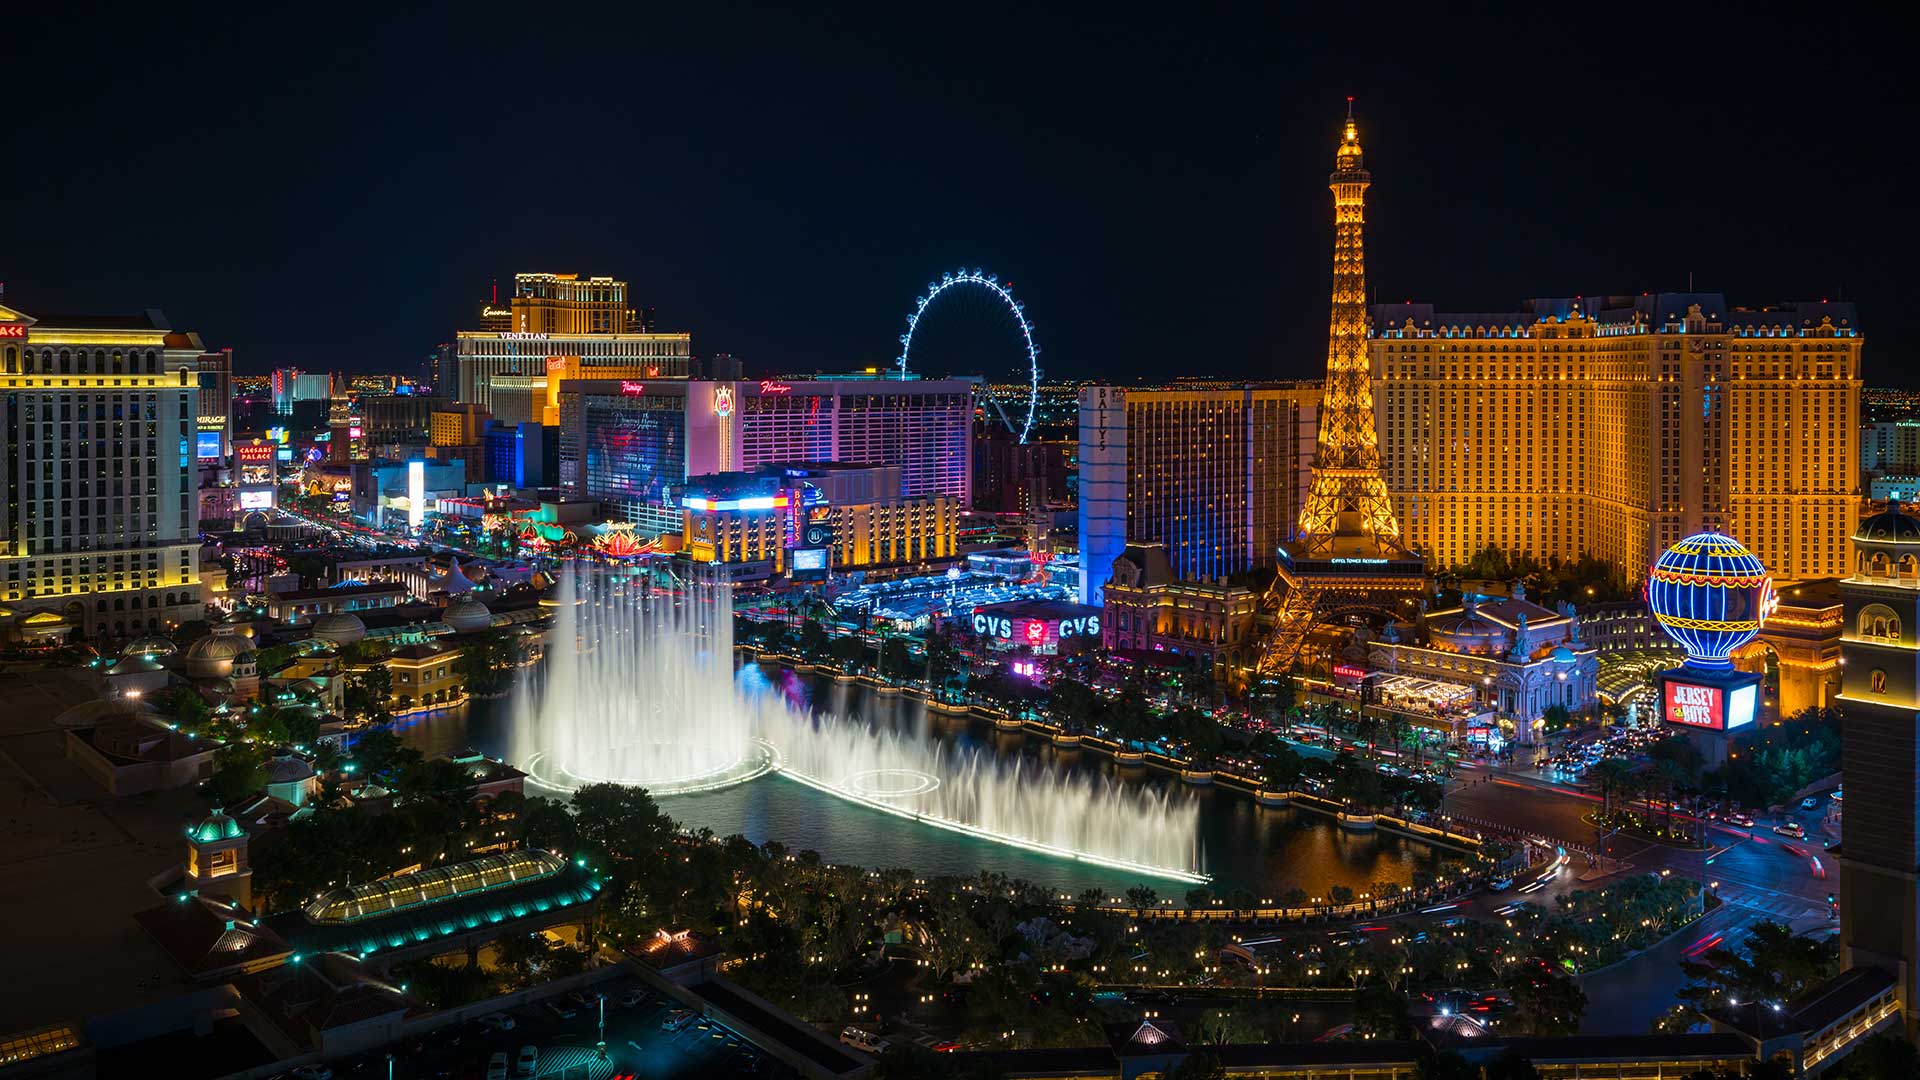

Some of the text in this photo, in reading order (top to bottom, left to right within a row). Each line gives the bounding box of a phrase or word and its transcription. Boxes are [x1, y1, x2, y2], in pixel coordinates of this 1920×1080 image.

[500, 332, 547, 340] VENETIAN
[622, 380, 644, 395] Flamingo
[760, 380, 791, 394] Flamingo
[974, 614, 1012, 639] CVS
[1059, 615, 1100, 639] CVS
[1333, 666, 1365, 677] BEER PARK
[1673, 685, 1713, 707] JERSEY
[1682, 704, 1711, 724] BOYS
